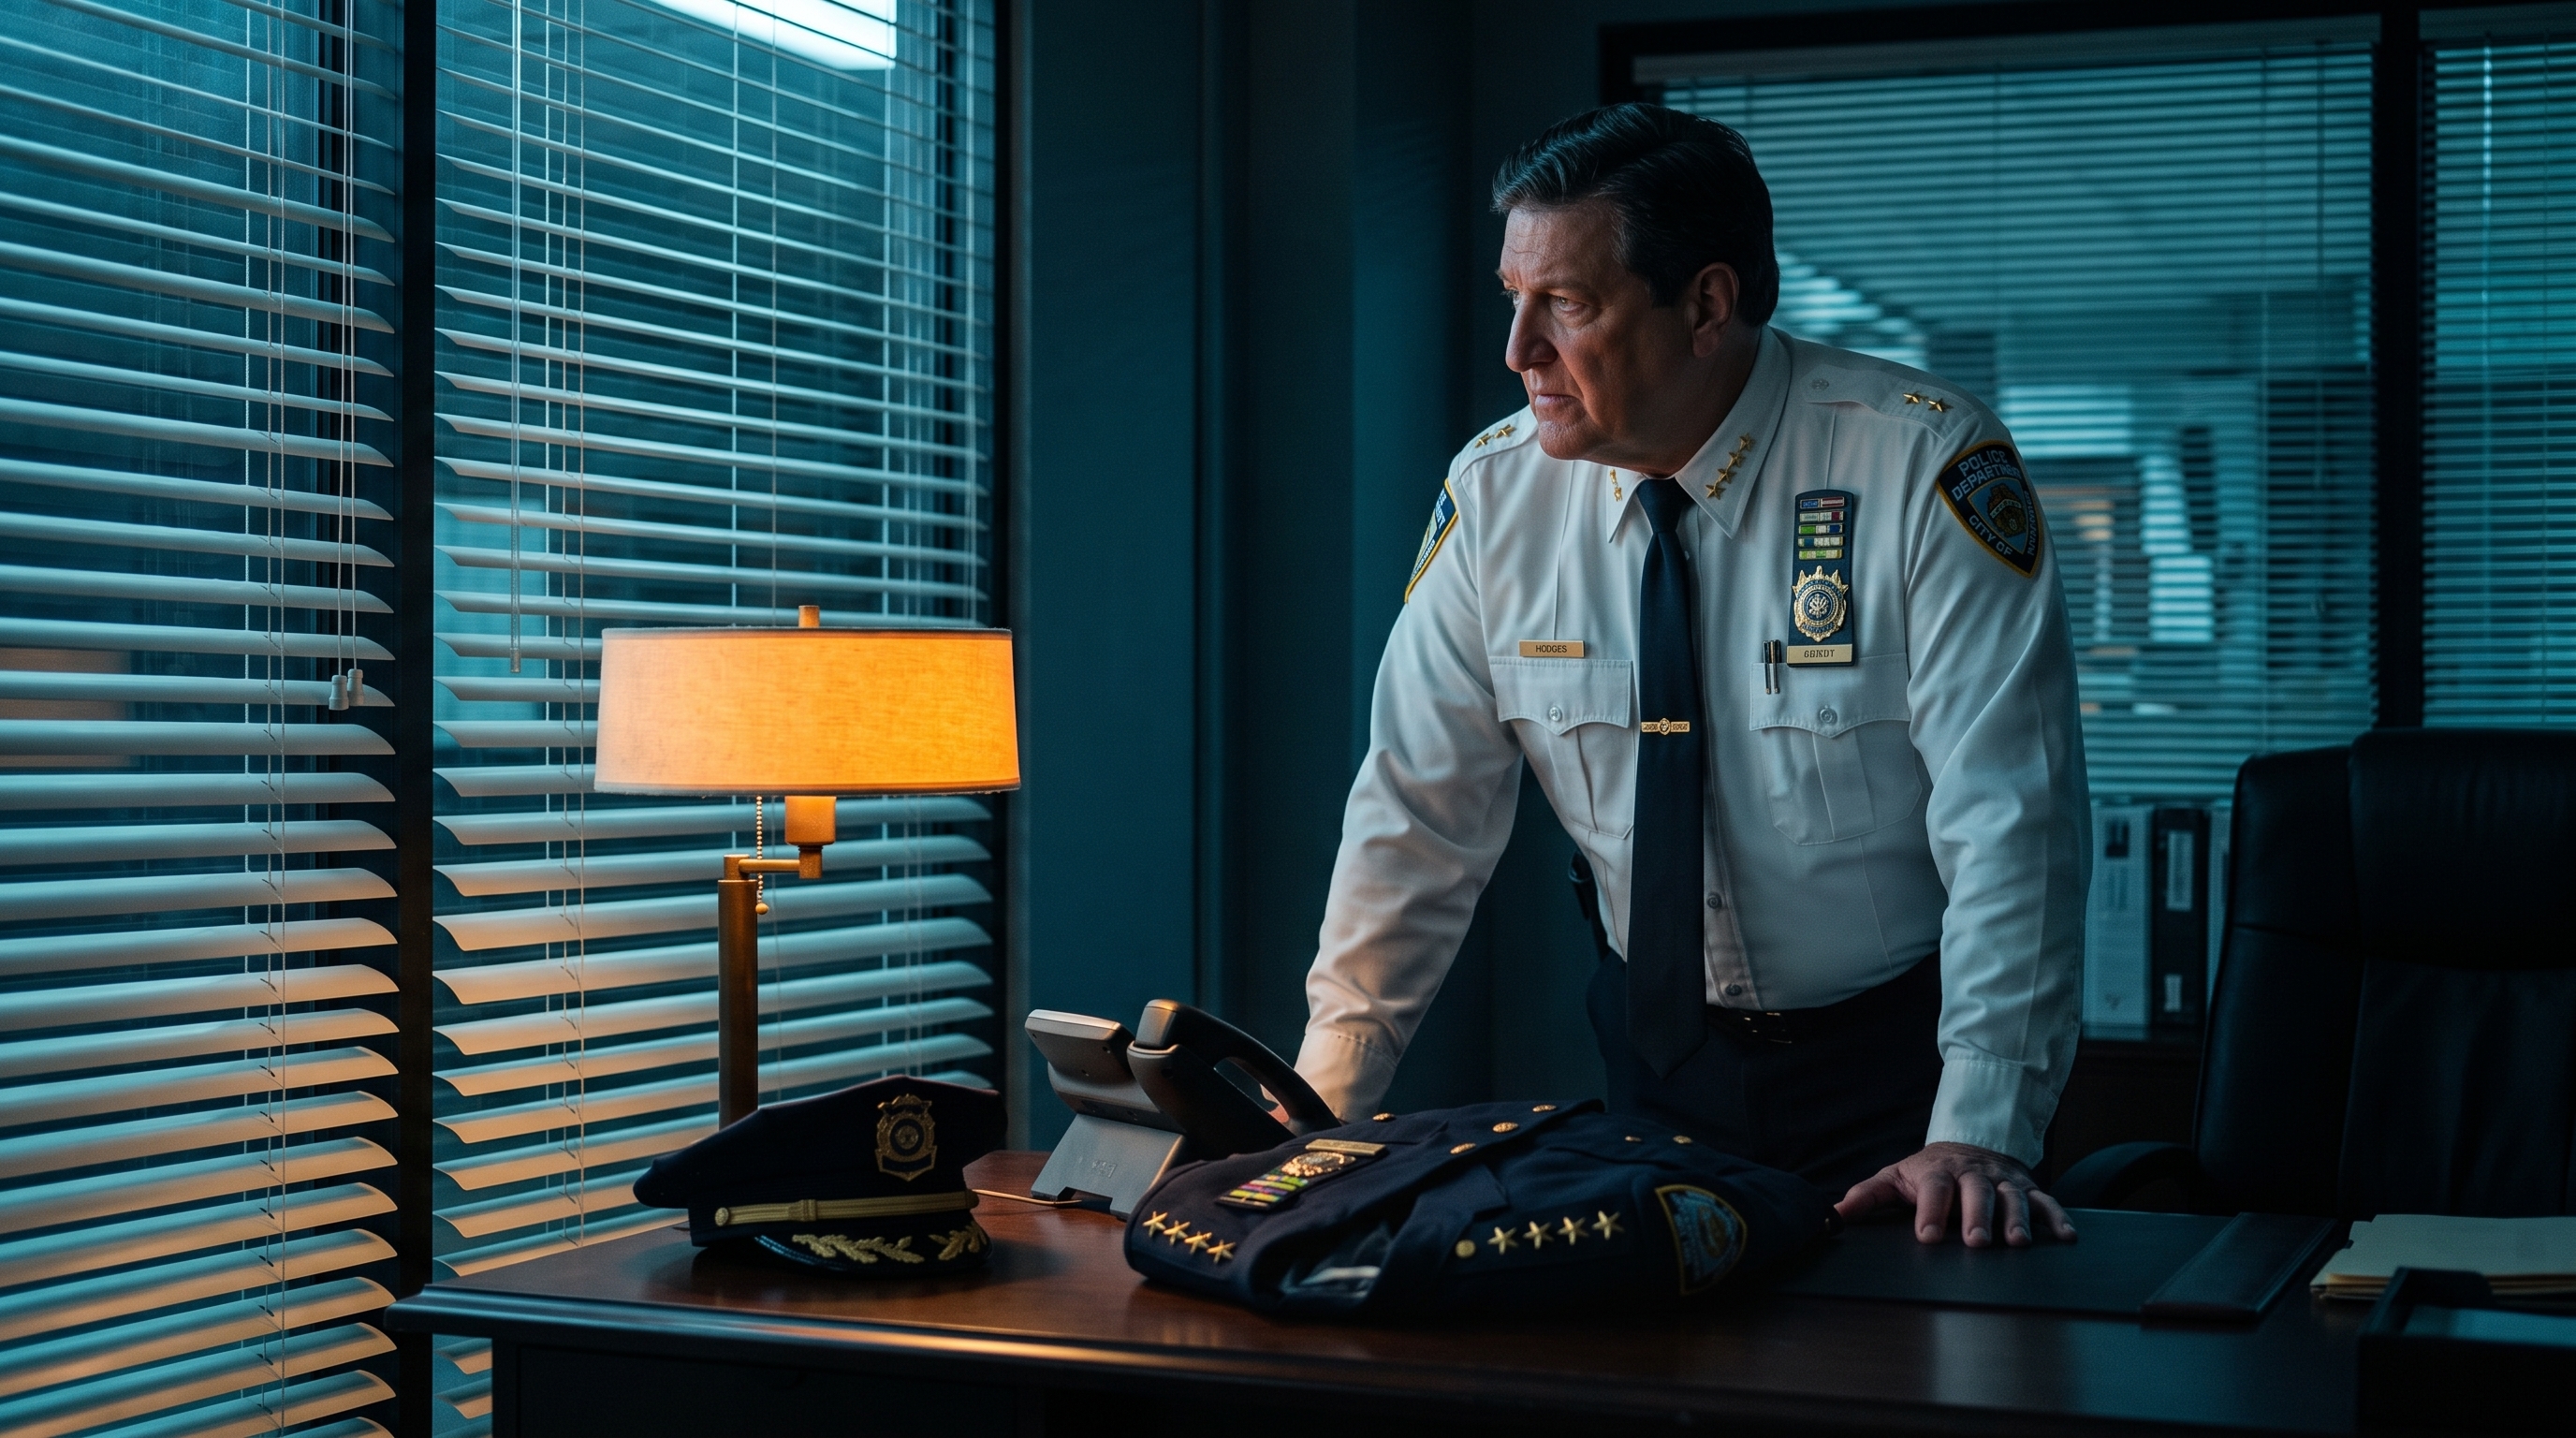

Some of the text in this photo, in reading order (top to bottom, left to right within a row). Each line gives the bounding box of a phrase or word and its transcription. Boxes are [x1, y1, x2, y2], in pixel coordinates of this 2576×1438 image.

[1958, 449, 2008, 477] POLICE
[1969, 514, 2013, 555] CITY OF
[1535, 644, 1568, 653] HODGES
